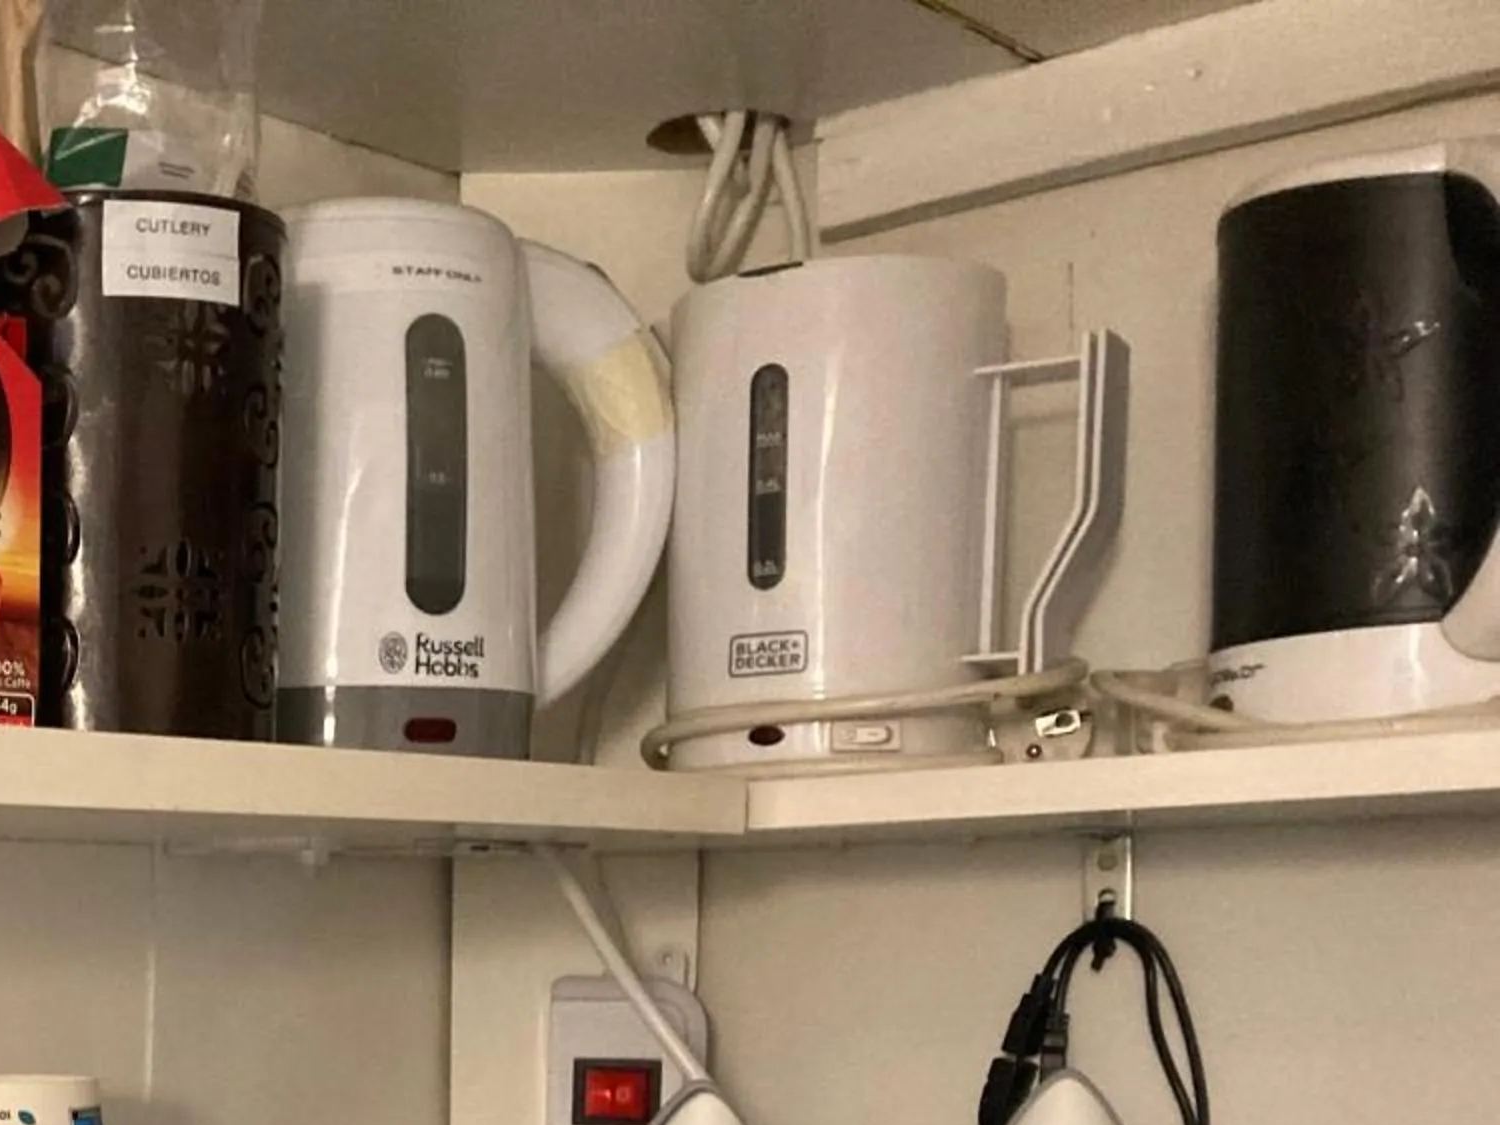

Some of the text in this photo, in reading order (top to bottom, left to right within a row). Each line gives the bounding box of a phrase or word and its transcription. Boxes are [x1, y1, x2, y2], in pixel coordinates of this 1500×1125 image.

[136, 218, 211, 236] CUTLERY
[126, 264, 222, 286] CUBIERTOS
[416, 632, 485, 658] Russell
[415, 654, 479, 679] Hobbs
[735, 653, 801, 669] DECKER
